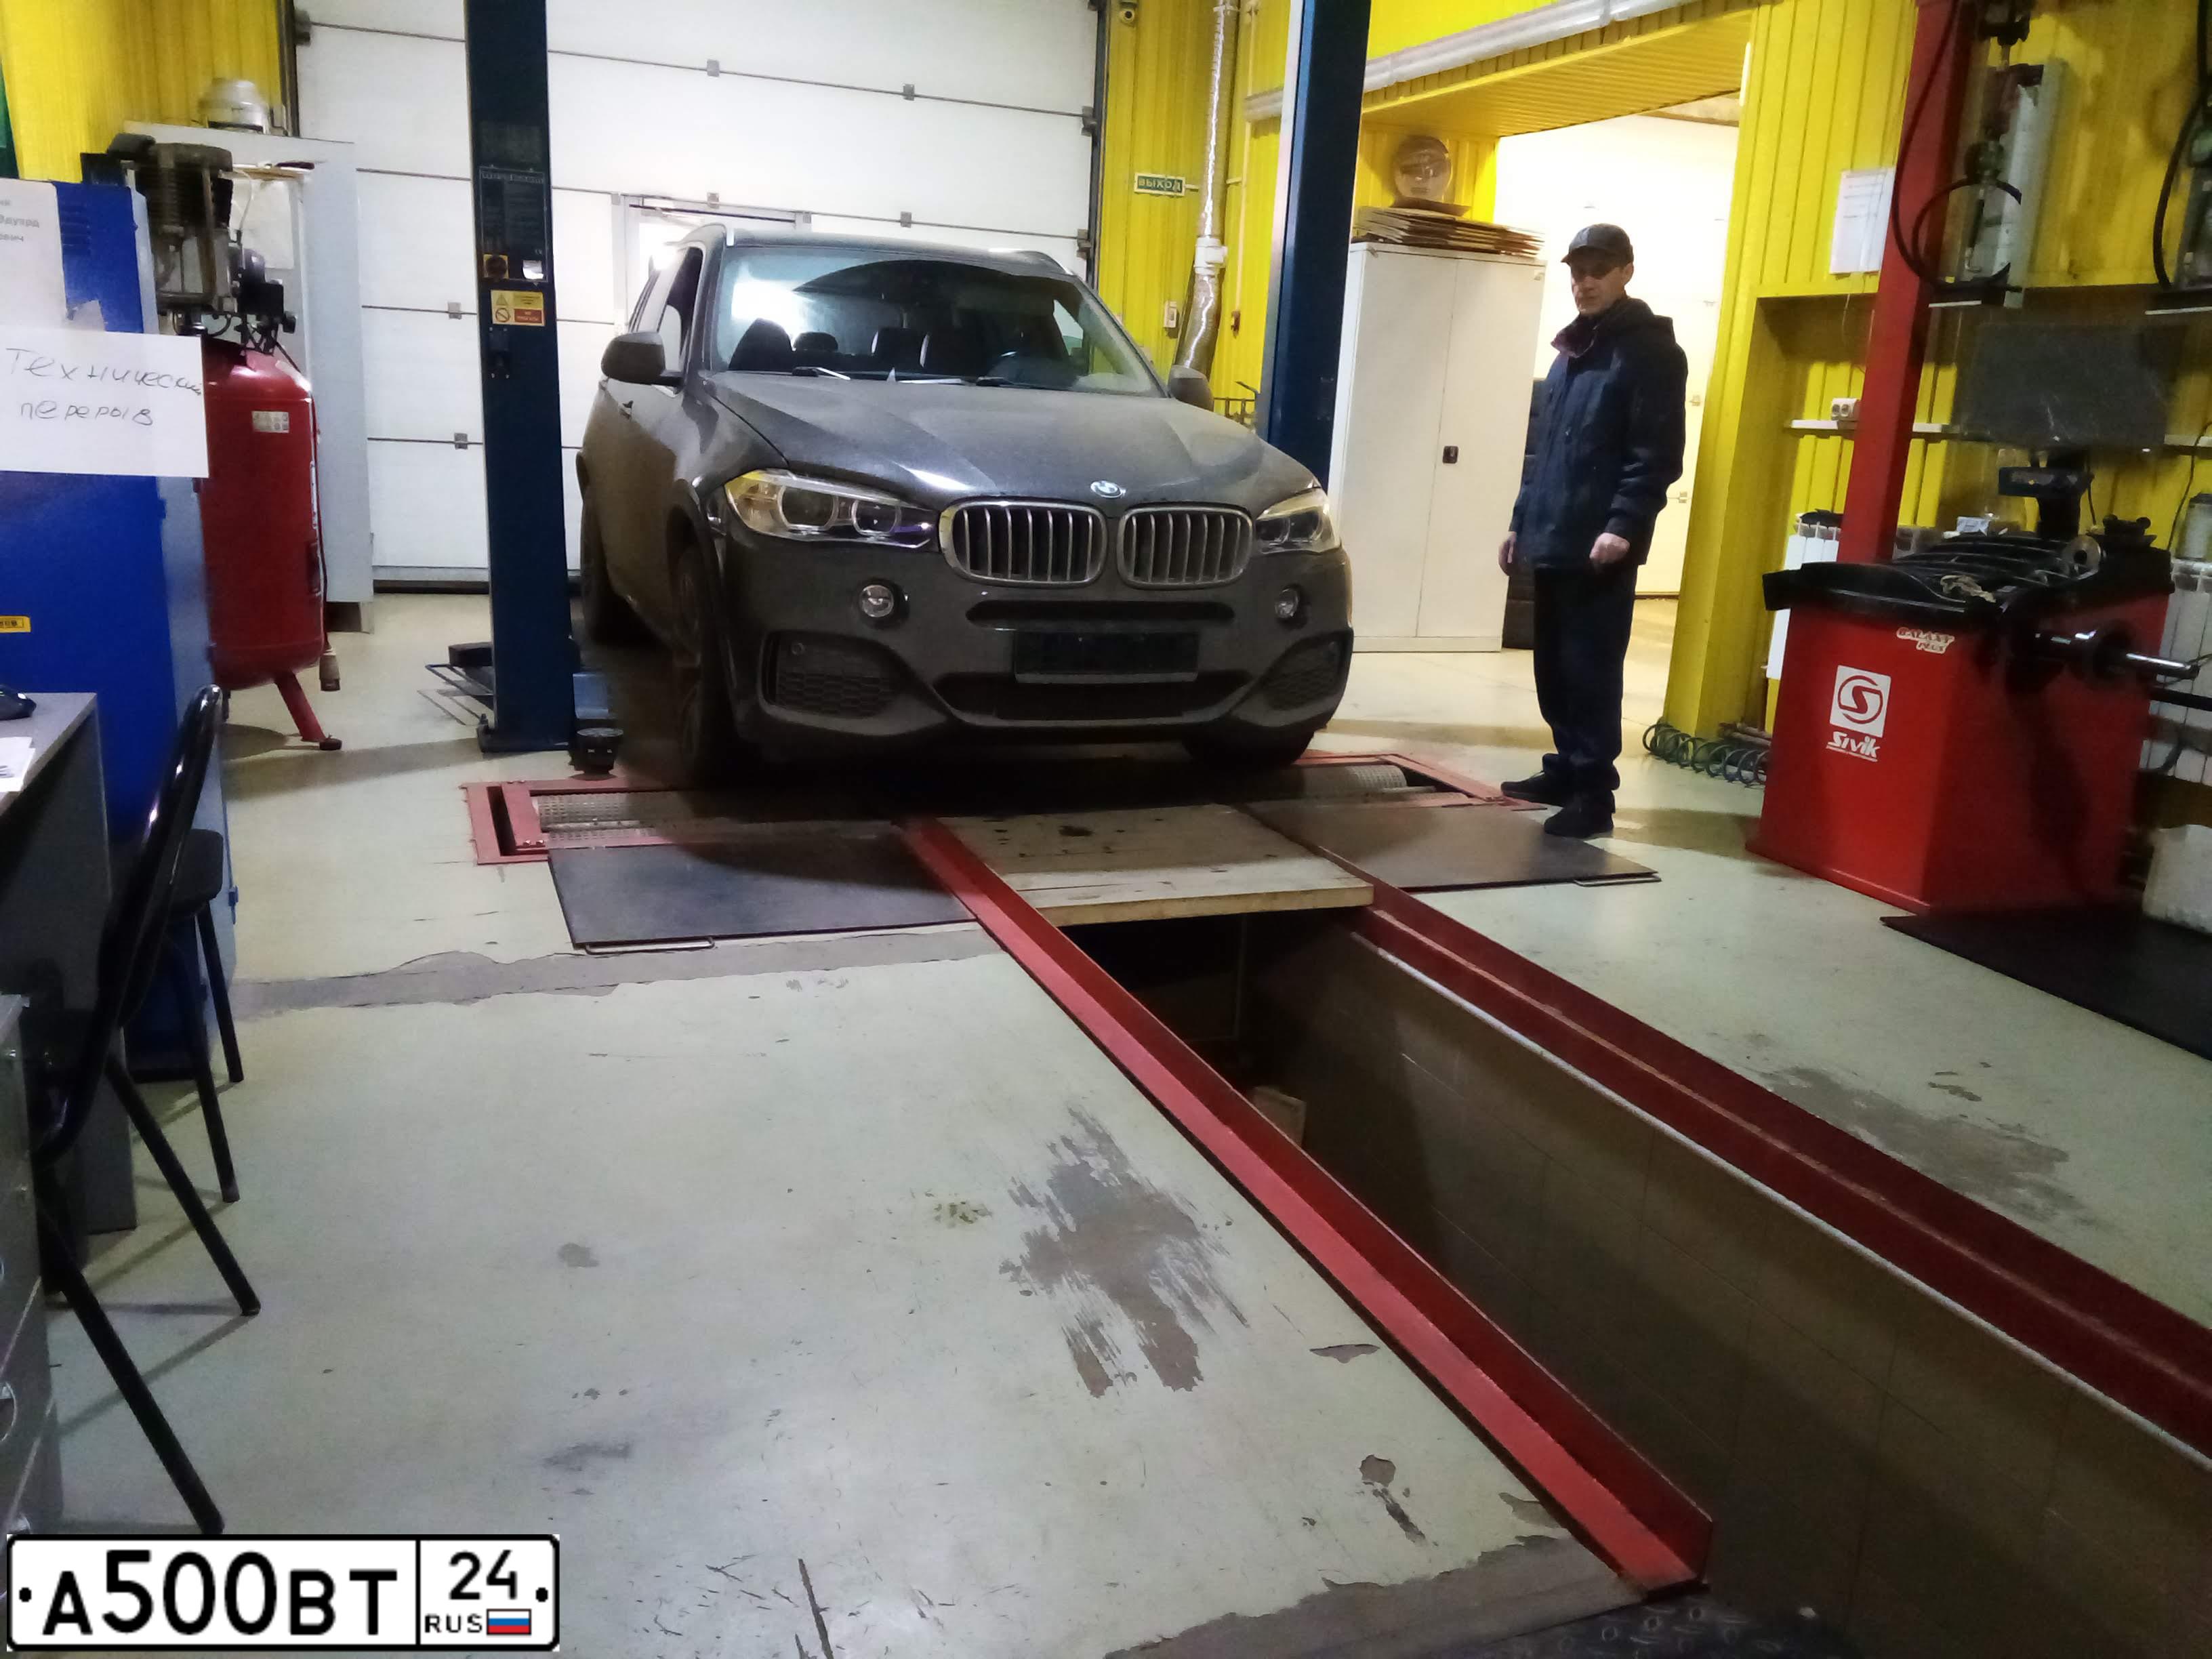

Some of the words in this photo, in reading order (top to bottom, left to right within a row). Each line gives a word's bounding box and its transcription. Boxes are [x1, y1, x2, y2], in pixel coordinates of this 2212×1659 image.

[1138, 177, 1181, 192] ВЫХОД
[21, 400, 154, 426] перерыв
[1827, 731, 1881, 758] Sivik
